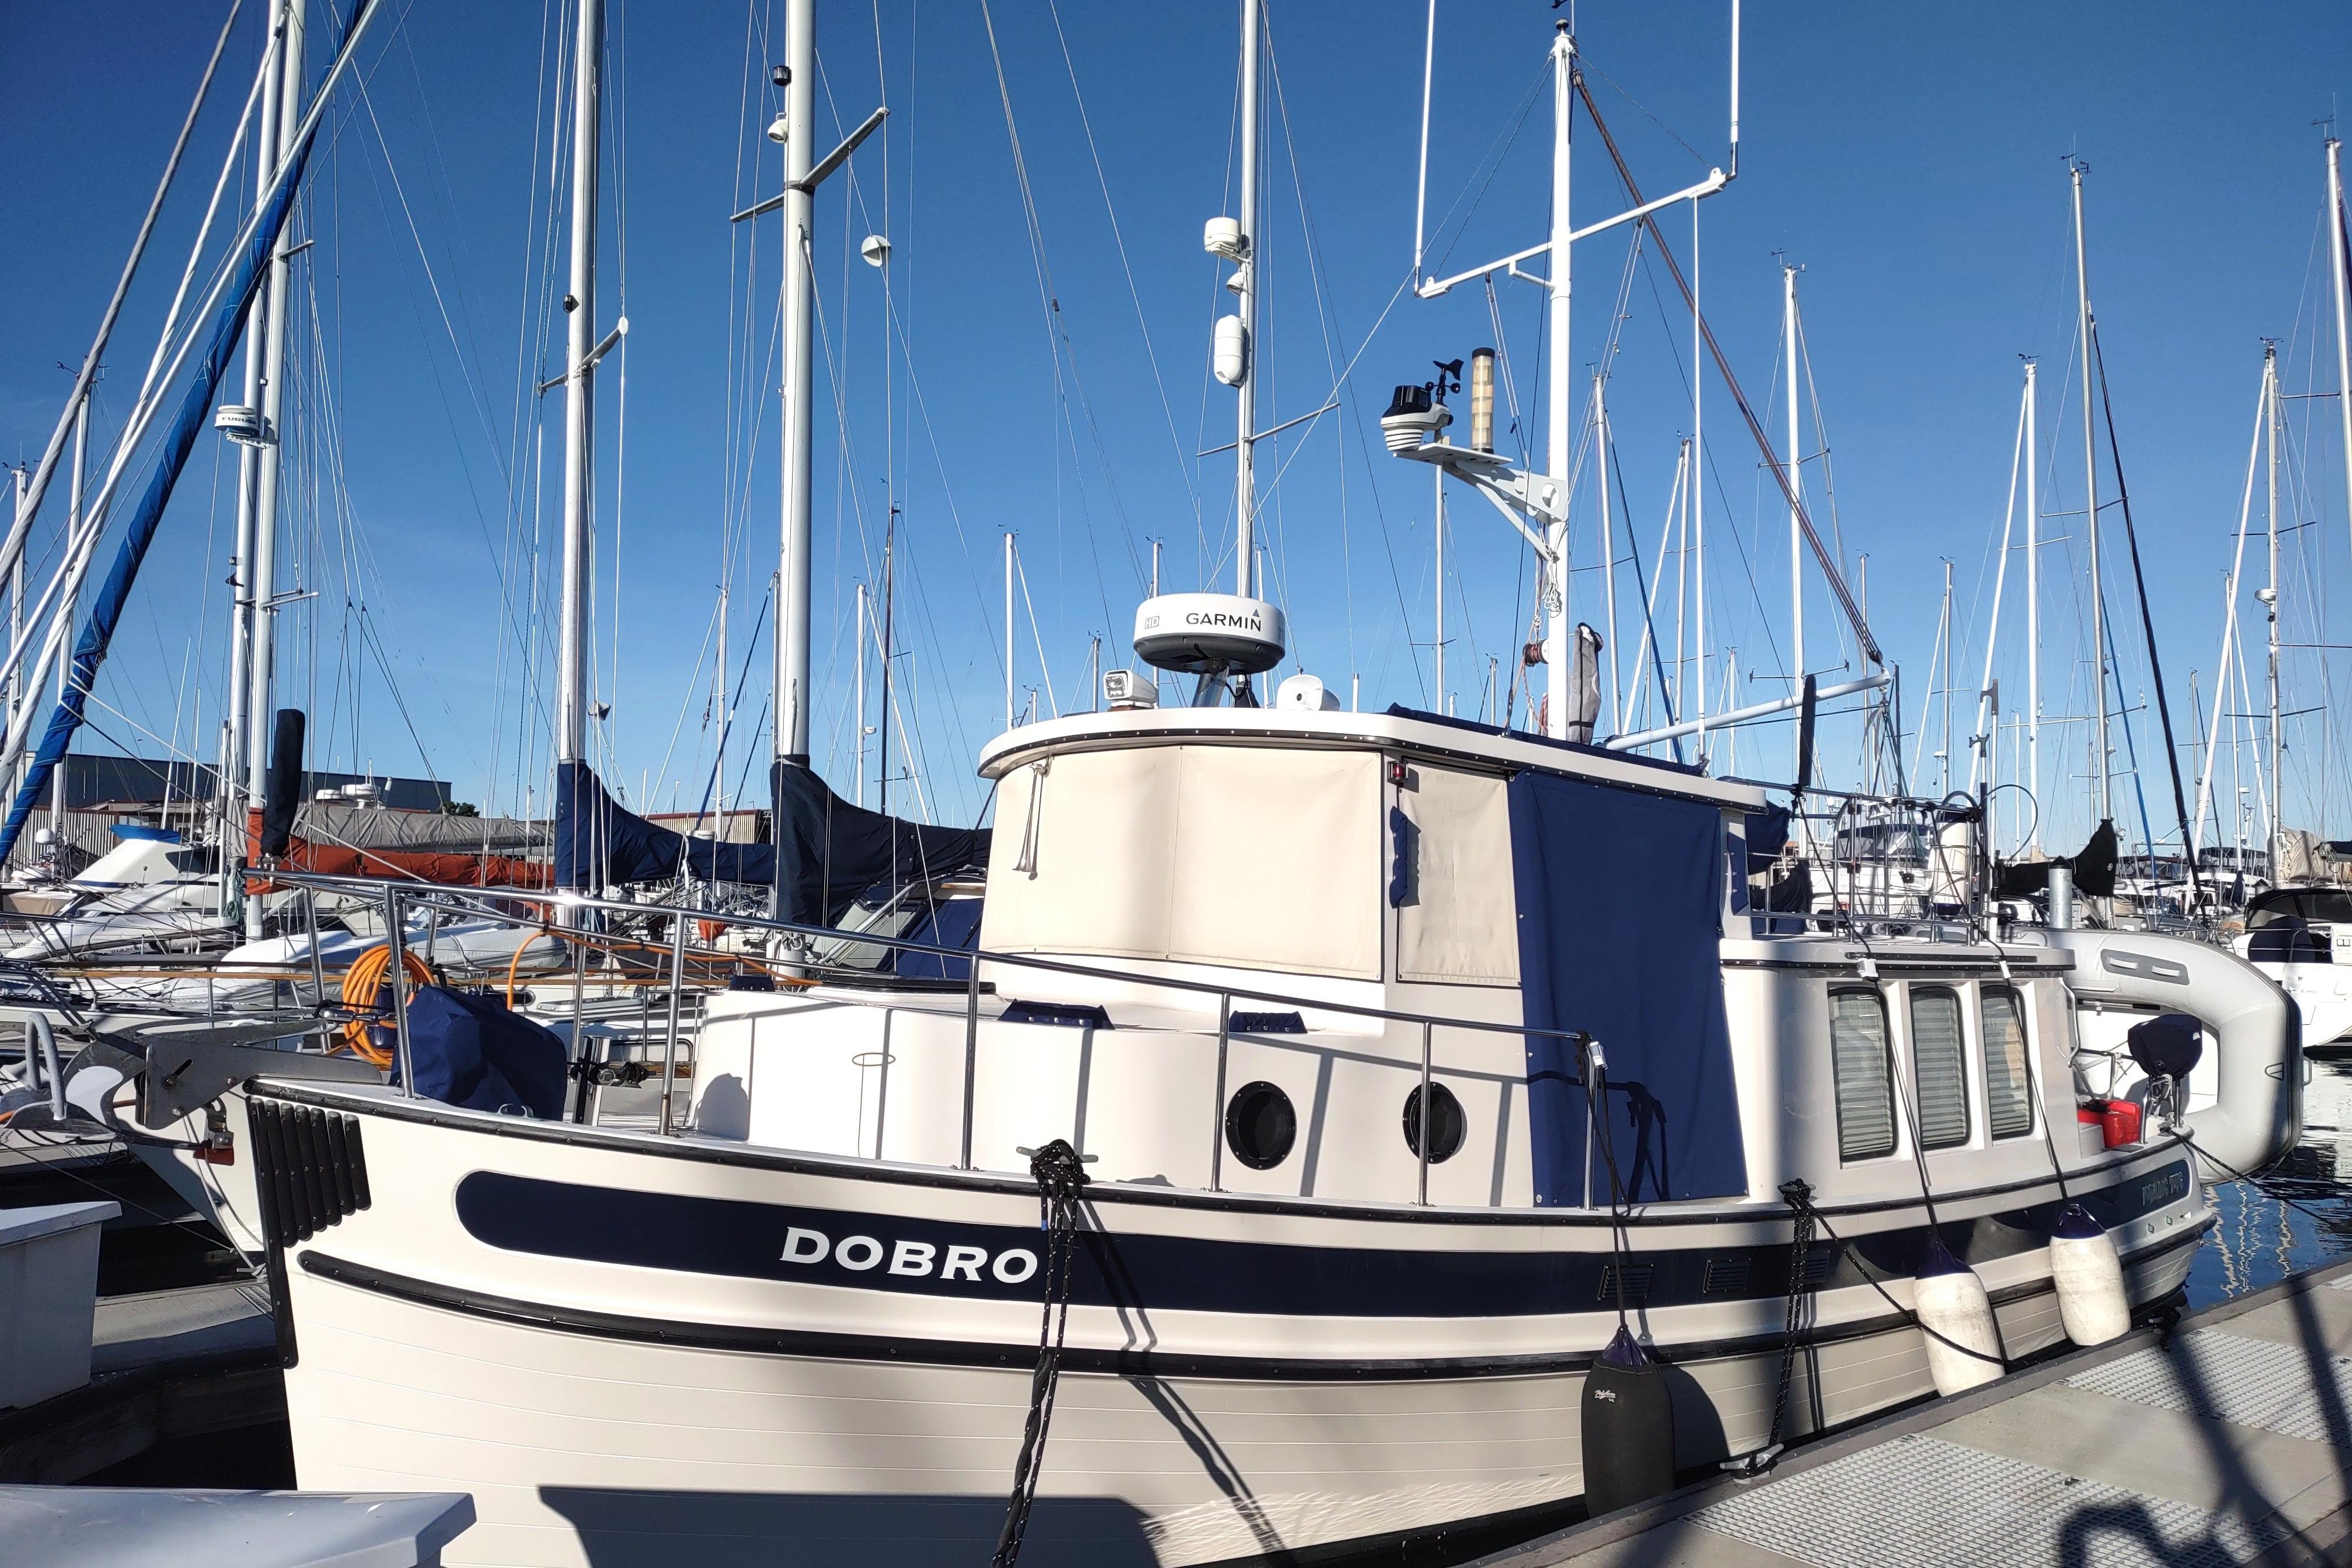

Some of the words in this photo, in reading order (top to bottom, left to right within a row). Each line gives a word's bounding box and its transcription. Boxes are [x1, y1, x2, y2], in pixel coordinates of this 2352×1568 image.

[222, 417, 257, 425] FURUNO
[1145, 617, 1160, 628] HD
[1186, 613, 1261, 632] GARMIN
[779, 1226, 1038, 1283] DOBRO
[1594, 1390, 1616, 1400] Polyform
